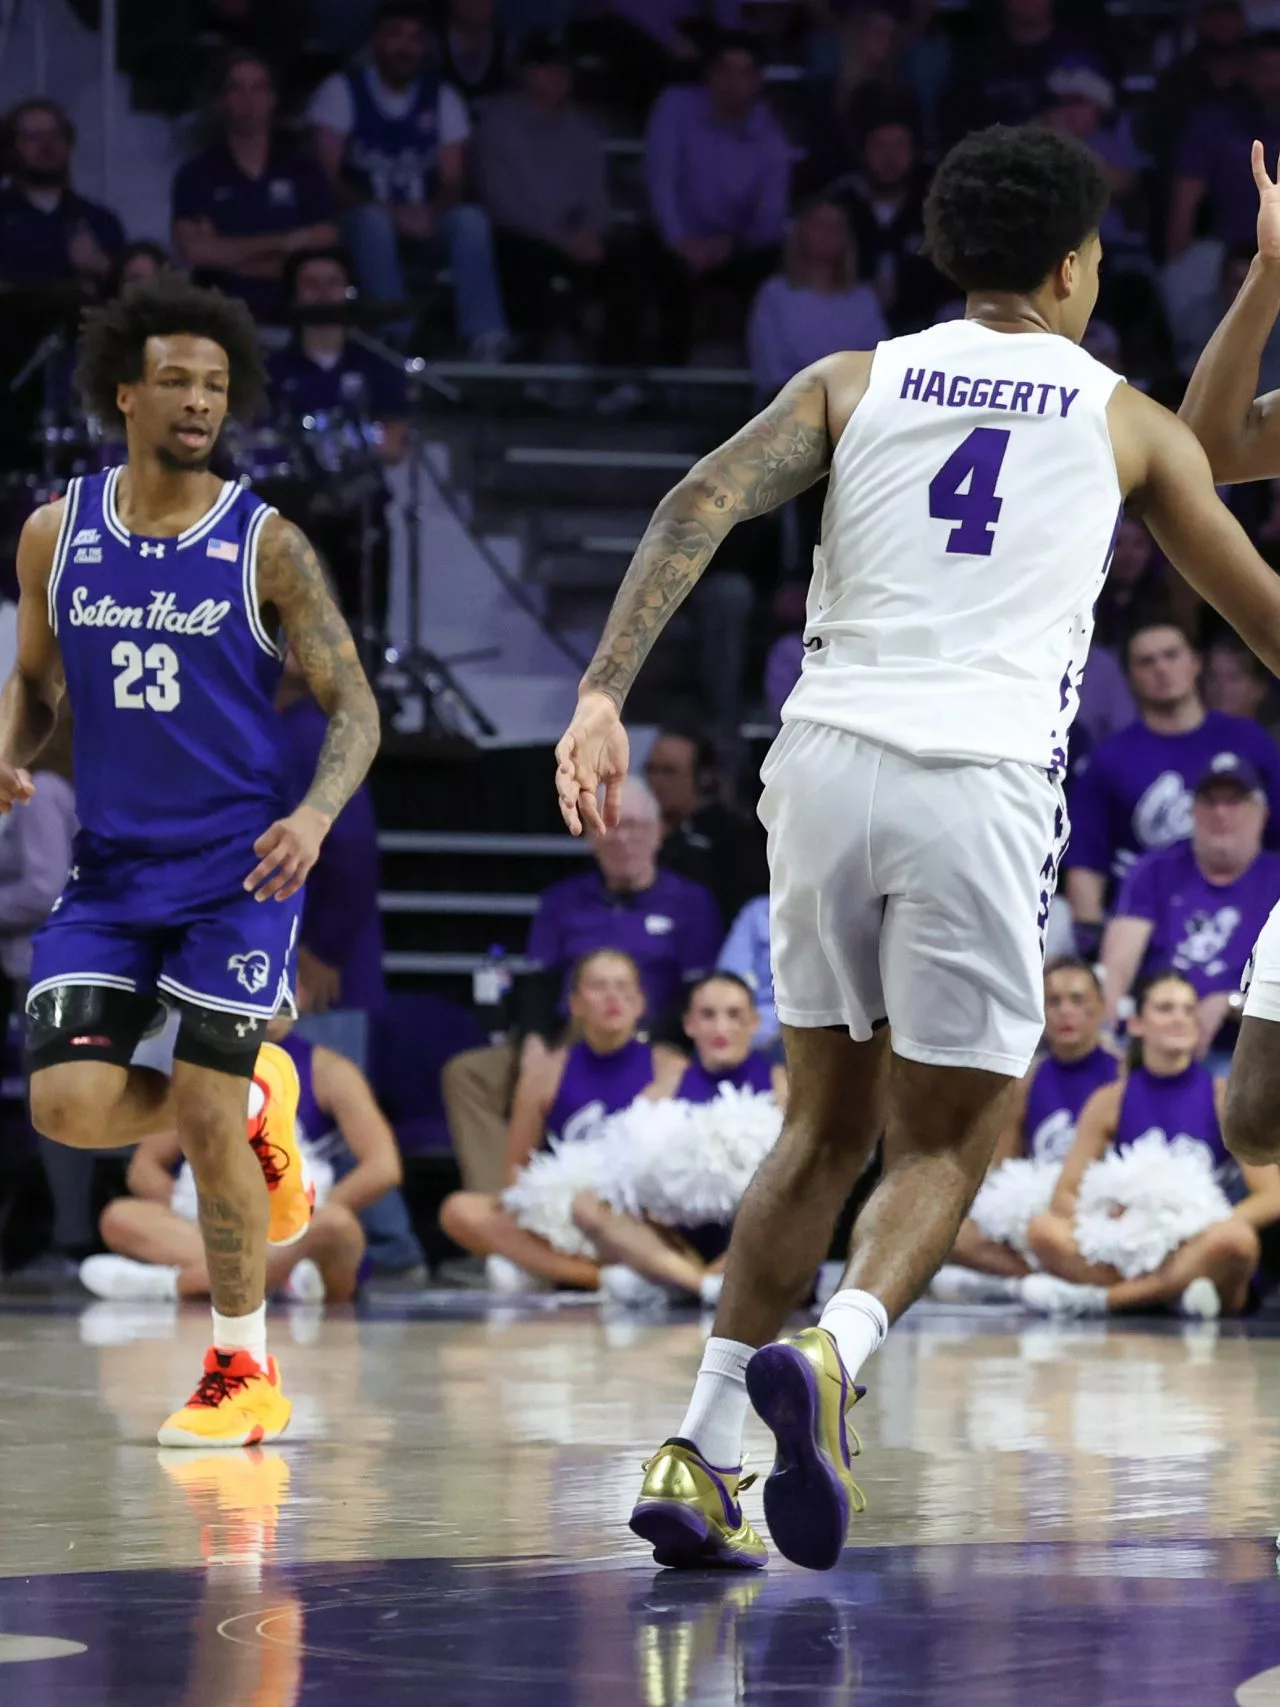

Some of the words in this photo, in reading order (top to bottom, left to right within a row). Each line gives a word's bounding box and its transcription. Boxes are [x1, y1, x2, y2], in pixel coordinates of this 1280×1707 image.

[899, 367, 1080, 418] HAGGERTY
[929, 427, 1011, 556] 4
[69, 586, 144, 629] Seton
[146, 590, 231, 636] Hall
[111, 640, 181, 712] 23
